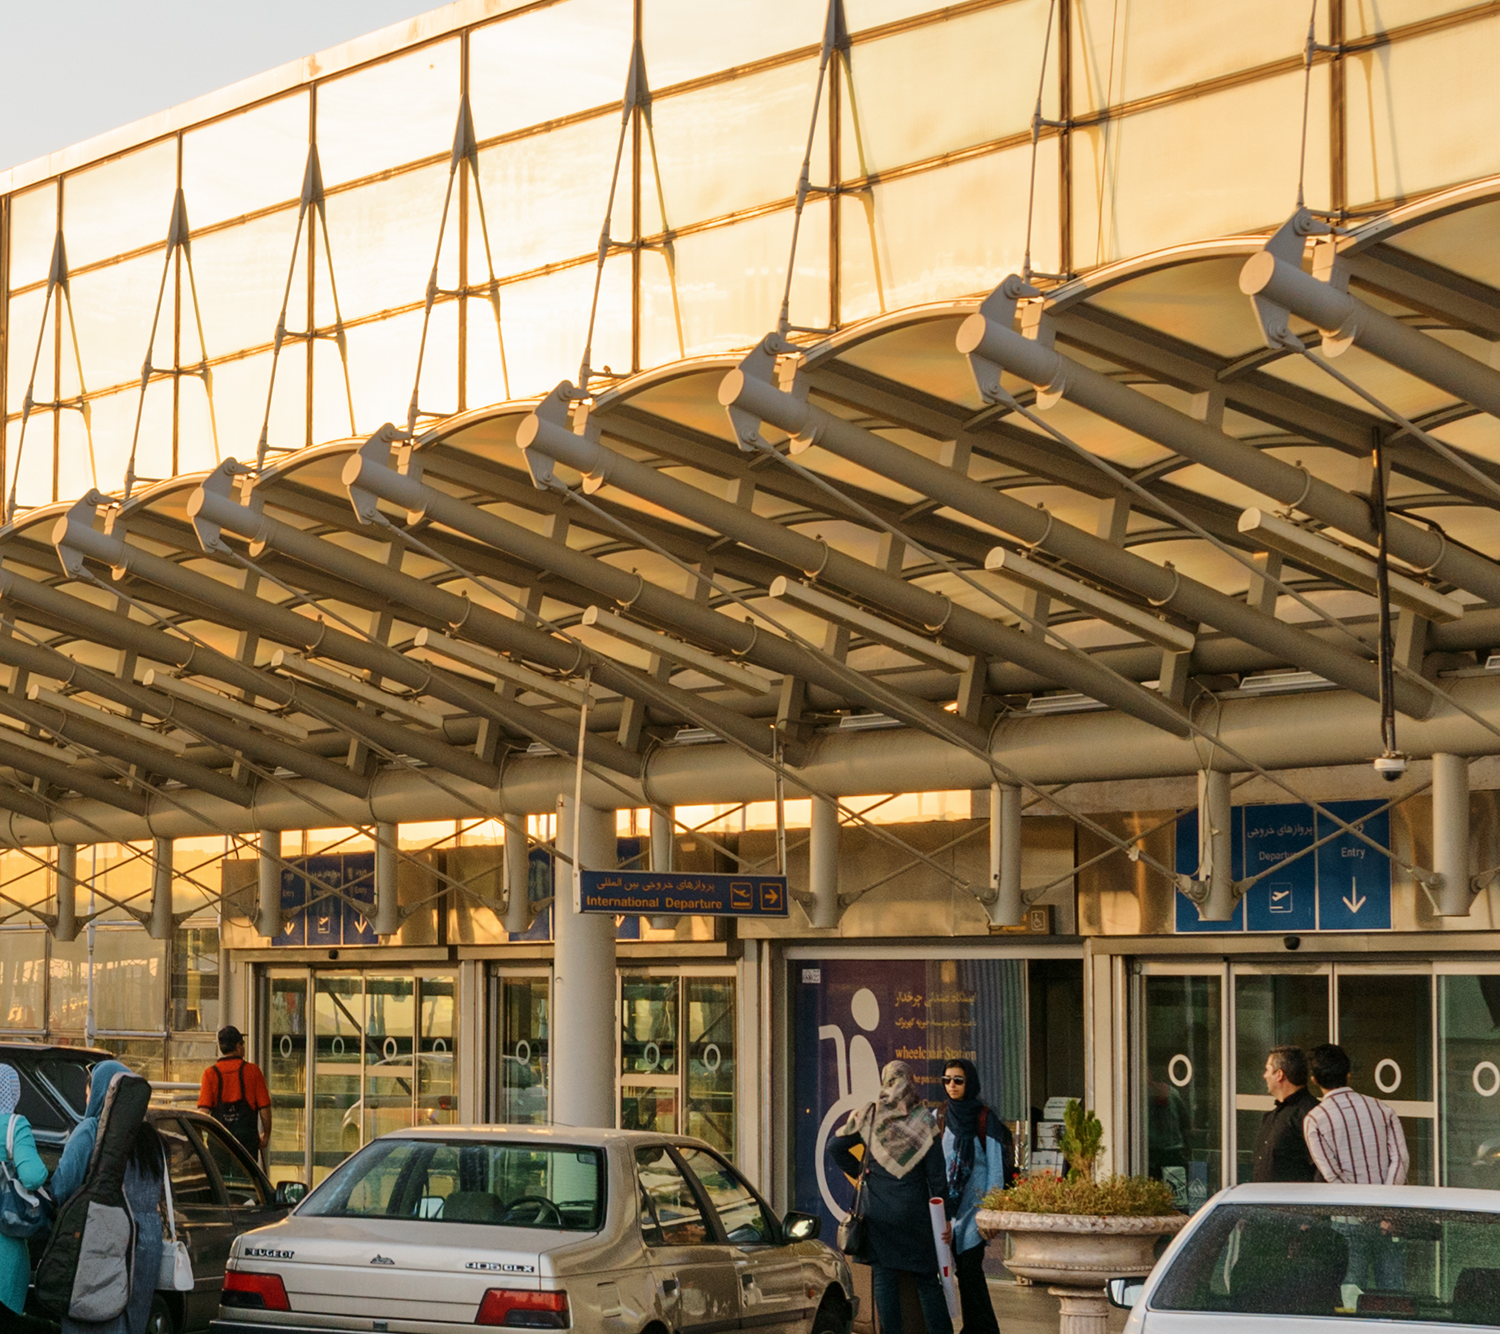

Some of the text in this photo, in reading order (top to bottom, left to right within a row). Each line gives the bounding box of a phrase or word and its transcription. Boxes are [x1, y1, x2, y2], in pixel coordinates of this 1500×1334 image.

[1341, 847, 1365, 859] Entry
[624, 881, 639, 891] بین
[676, 879, 715, 892] پروازهای
[586, 895, 722, 910] International Departure
